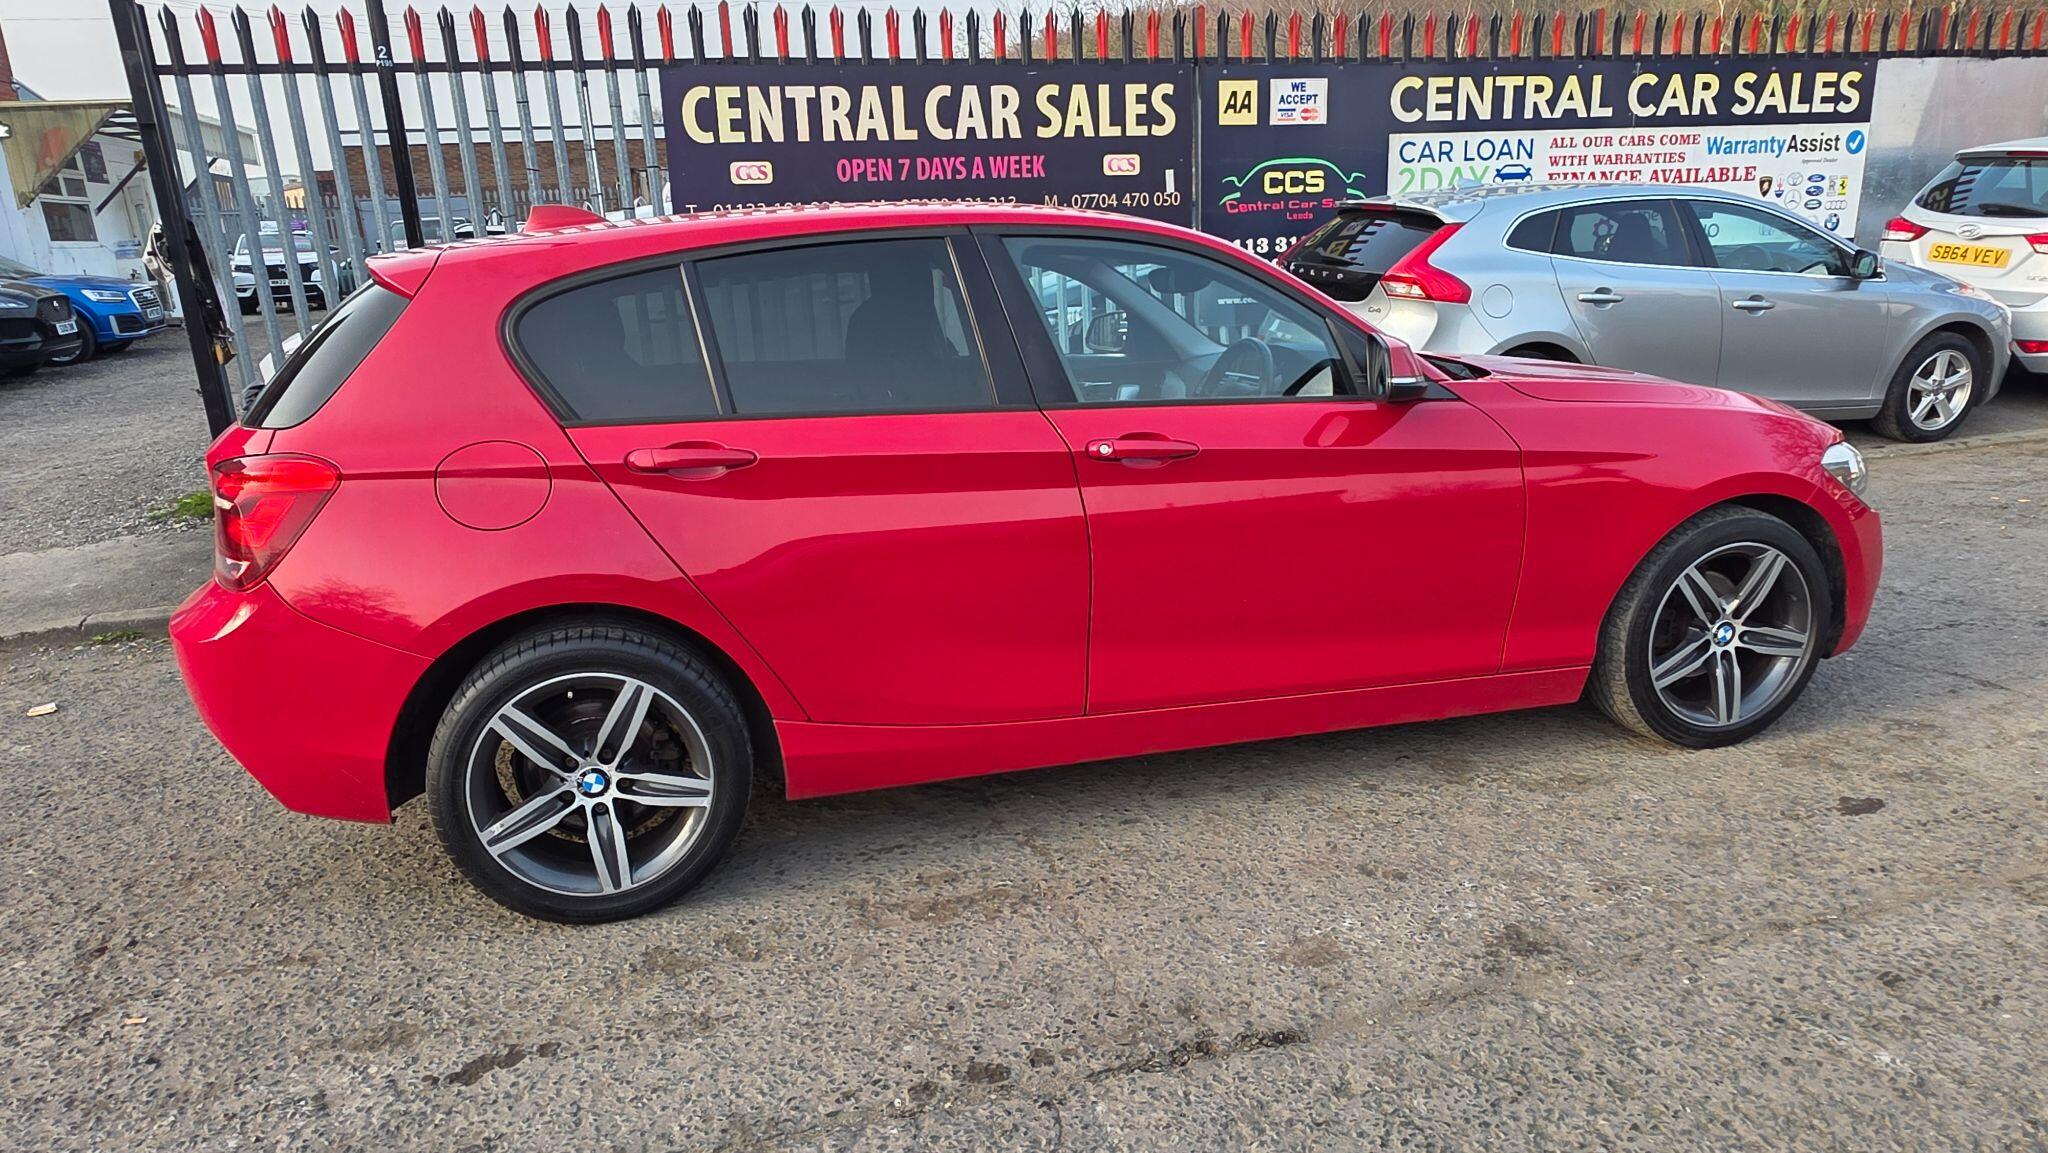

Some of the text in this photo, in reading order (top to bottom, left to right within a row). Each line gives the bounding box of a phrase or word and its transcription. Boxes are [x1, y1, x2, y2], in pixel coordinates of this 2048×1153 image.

[378, 45, 388, 59] 2
[1291, 82, 1306, 92] WE
[1223, 91, 1252, 114] AA
[1279, 94, 1318, 104] ACCEPT
[1390, 71, 1863, 123] CENTRAL CAR SALES
[682, 83, 1176, 144] CENTRAL CAR SALES
[1549, 133, 1701, 149] ALL OUR CARS COME
[1399, 138, 1534, 164] CAR LOAN
[1549, 152, 1686, 167] WITH WARRANTIES
[836, 155, 1046, 183] OPEN 7 DAYS A WEEK
[1650, 166, 1757, 183] AVAILABLE
[1264, 170, 1325, 194] CCS
[1071, 193, 1118, 209] 07704
[1122, 192, 1149, 207] 470
[1154, 191, 1181, 206] 050
[1226, 200, 1284, 213] Central
[1288, 200, 1318, 209] Car
[1932, 245, 2005, 264] SB64 VEV
